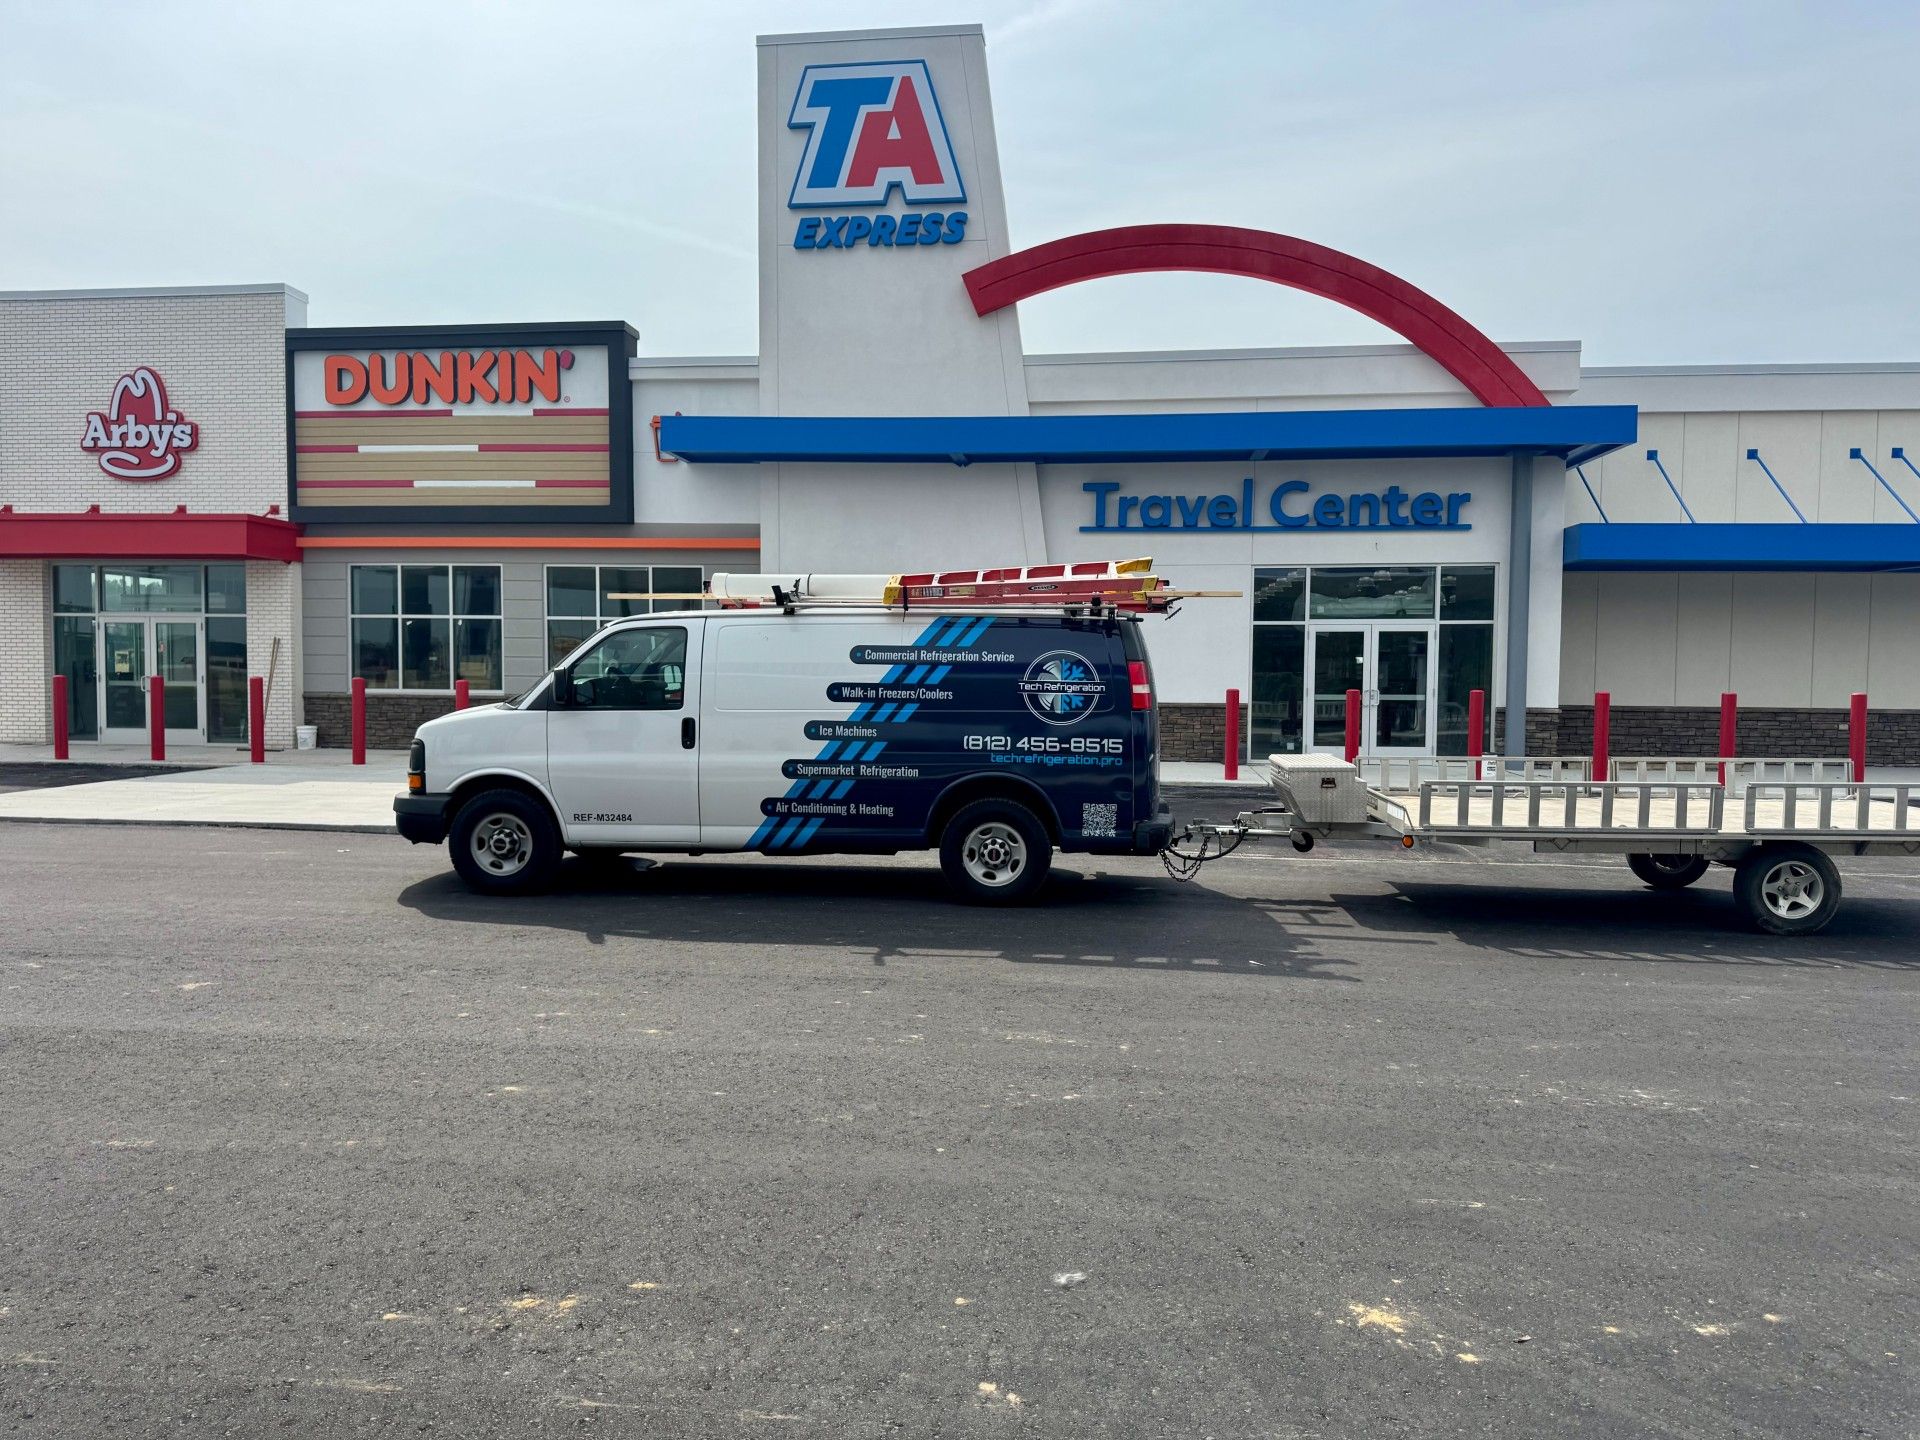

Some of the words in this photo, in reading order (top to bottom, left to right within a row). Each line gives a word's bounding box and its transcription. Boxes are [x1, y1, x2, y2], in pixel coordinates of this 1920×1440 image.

[805, 75, 945, 188] TA
[793, 212, 968, 250] EXPRESS
[324, 348, 576, 405] DUNKIN'
[82, 412, 193, 458] Arby's
[1082, 479, 1253, 528] Travel
[1270, 480, 1471, 527] Center
[865, 649, 917, 661] Commercial
[920, 650, 979, 663] Refrigeration
[981, 651, 1015, 662] Service
[842, 687, 876, 698] Walk-in
[878, 687, 953, 700] Freezers/Coolers
[1018, 682, 1043, 691] Tech
[1044, 682, 1106, 694] Refrigeration
[819, 724, 833, 736] Ice
[835, 725, 877, 737] Machines
[963, 735, 1011, 751] (812)
[1016, 736, 1123, 753] 456-8515
[990, 752, 1123, 768] techrefrigeration.pro
[797, 763, 855, 776] Supermarket
[860, 765, 919, 778] Refrigeration
[775, 802, 789, 813] Air
[791, 802, 847, 815] Conditioning
[849, 804, 857, 815] &
[859, 804, 894, 816] Heating
[573, 813, 632, 822] REF-M32484
